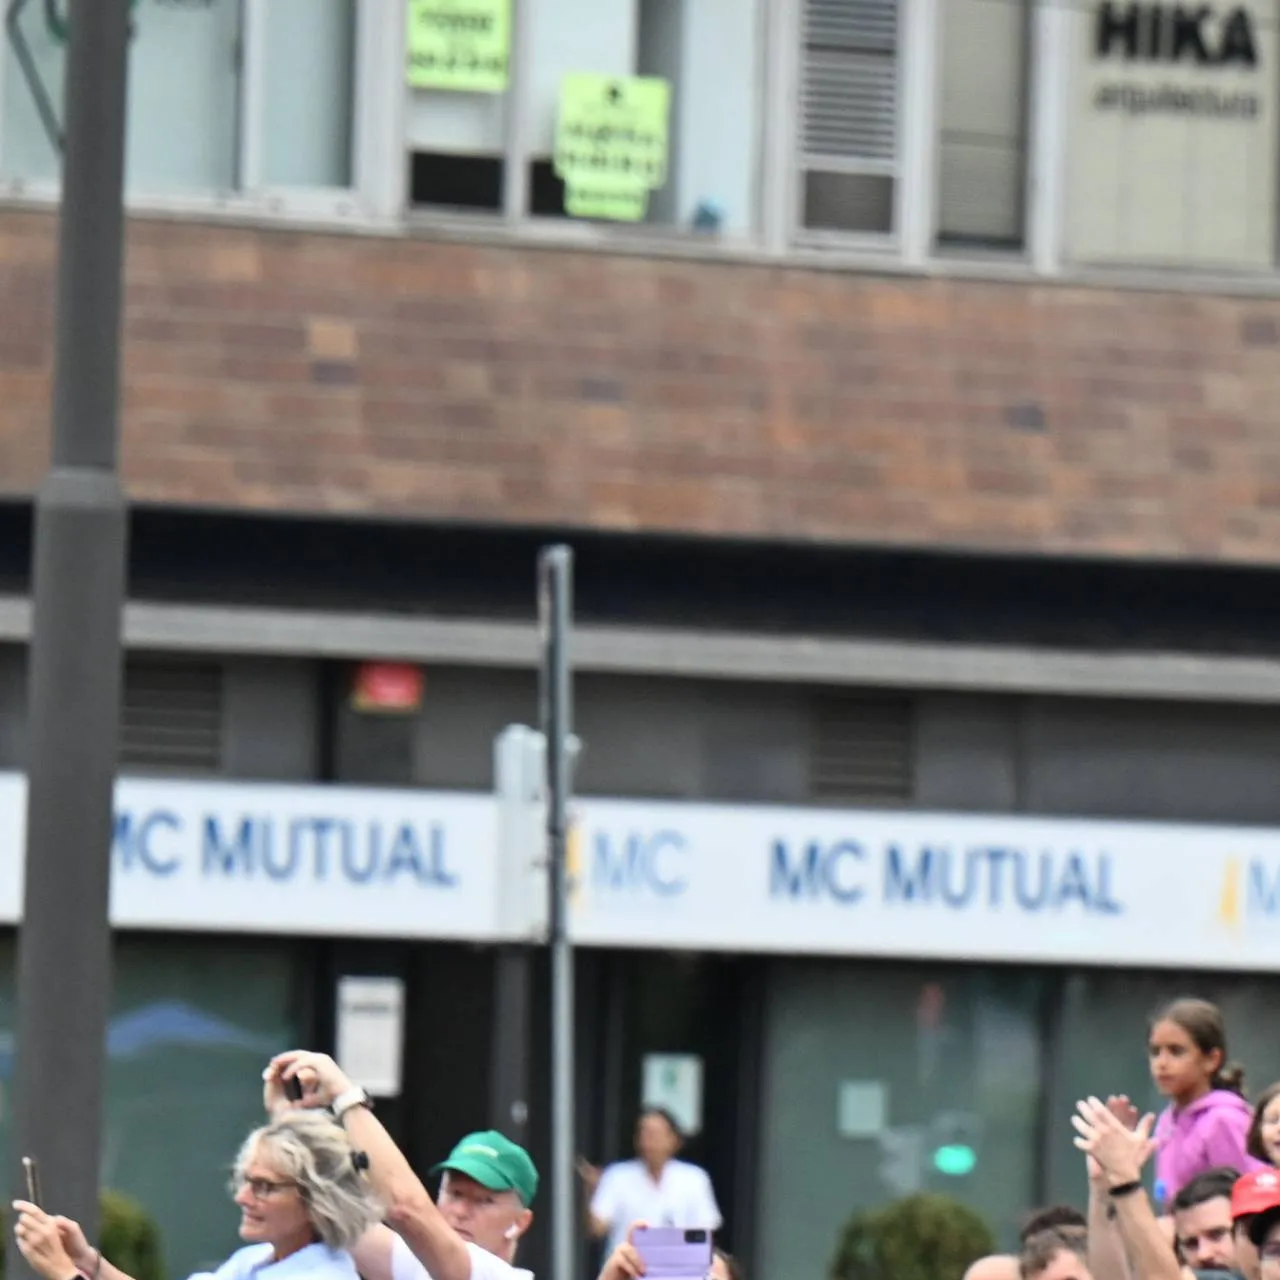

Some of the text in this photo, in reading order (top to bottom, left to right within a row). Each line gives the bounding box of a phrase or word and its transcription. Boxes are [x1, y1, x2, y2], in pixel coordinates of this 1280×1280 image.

[1095, 2, 1257, 66] HIKA
[200, 814, 458, 888] MUTUAL
[592, 829, 688, 896] MC
[768, 837, 1124, 916] MC MUTUAL
